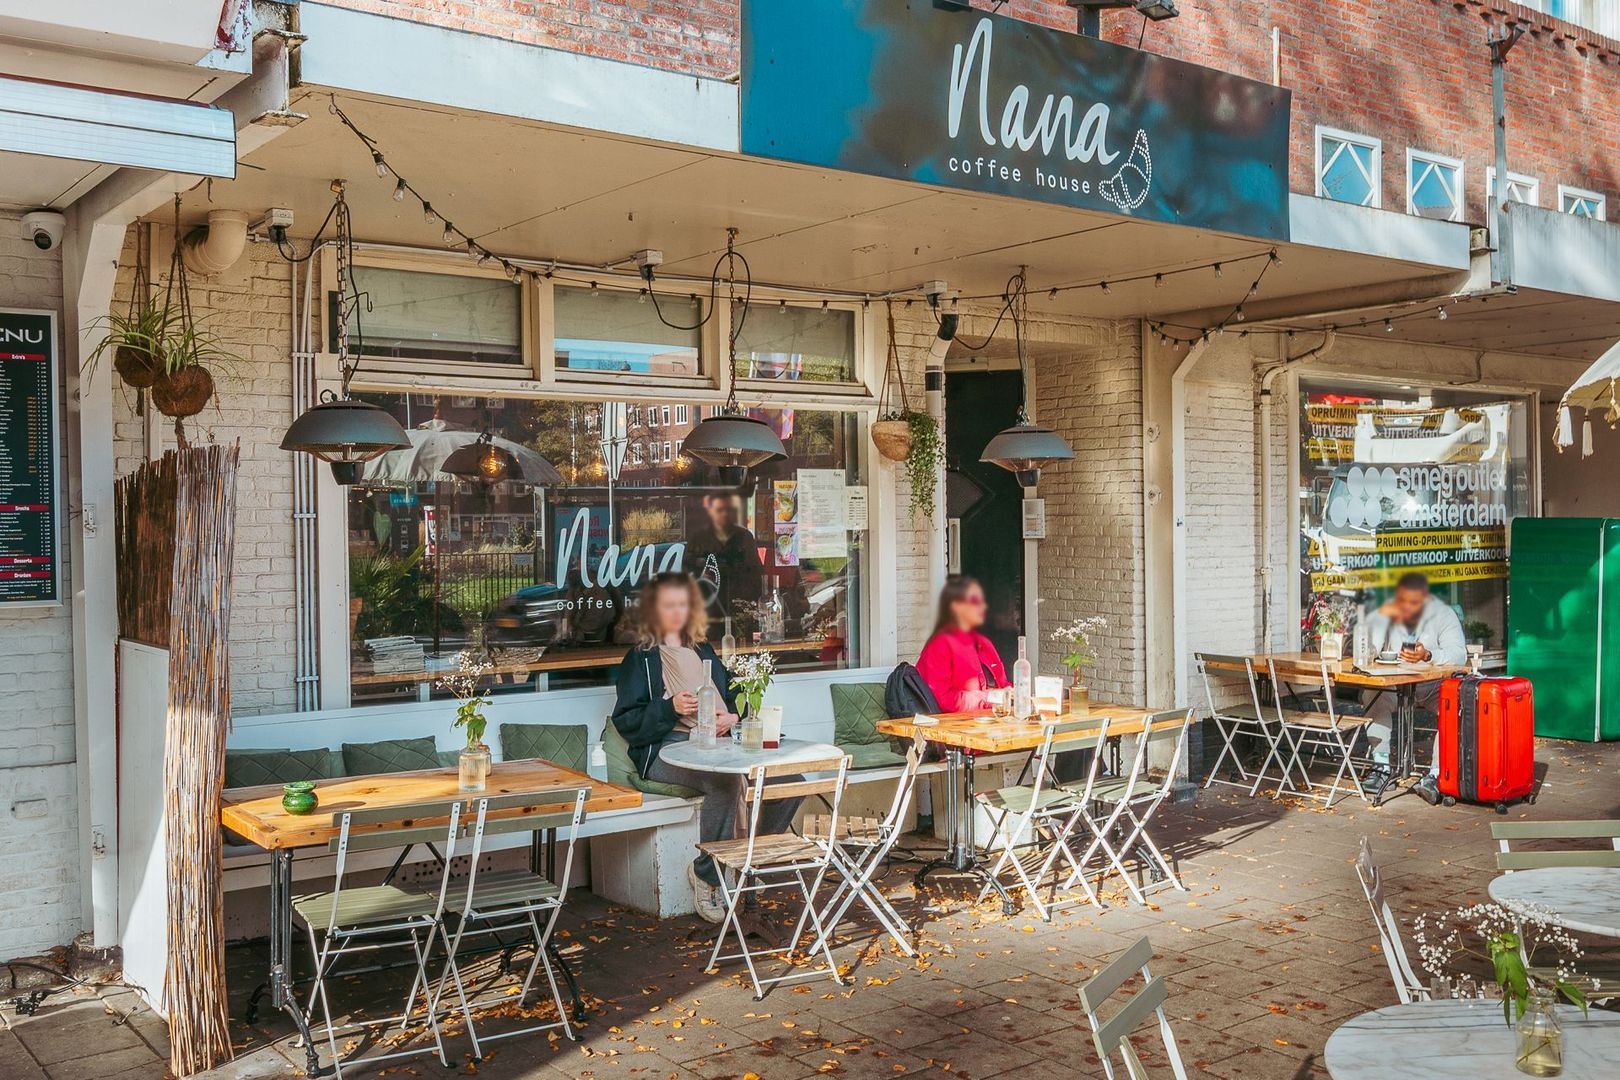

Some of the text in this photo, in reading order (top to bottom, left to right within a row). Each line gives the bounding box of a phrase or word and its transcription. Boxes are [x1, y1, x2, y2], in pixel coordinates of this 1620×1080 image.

[948, 17, 1120, 165] Nana
[949, 157, 1090, 193] coffee house
[0, 328, 43, 343] NU
[1311, 423, 1439, 440] UITVERK UITVERKOO
[1400, 466, 1453, 498] smeg
[1456, 461, 1507, 491] outlet
[1400, 496, 1507, 528] amsterdam
[1389, 550, 1448, 566] UITVERKOOP
[557, 597, 613, 611] coffee
